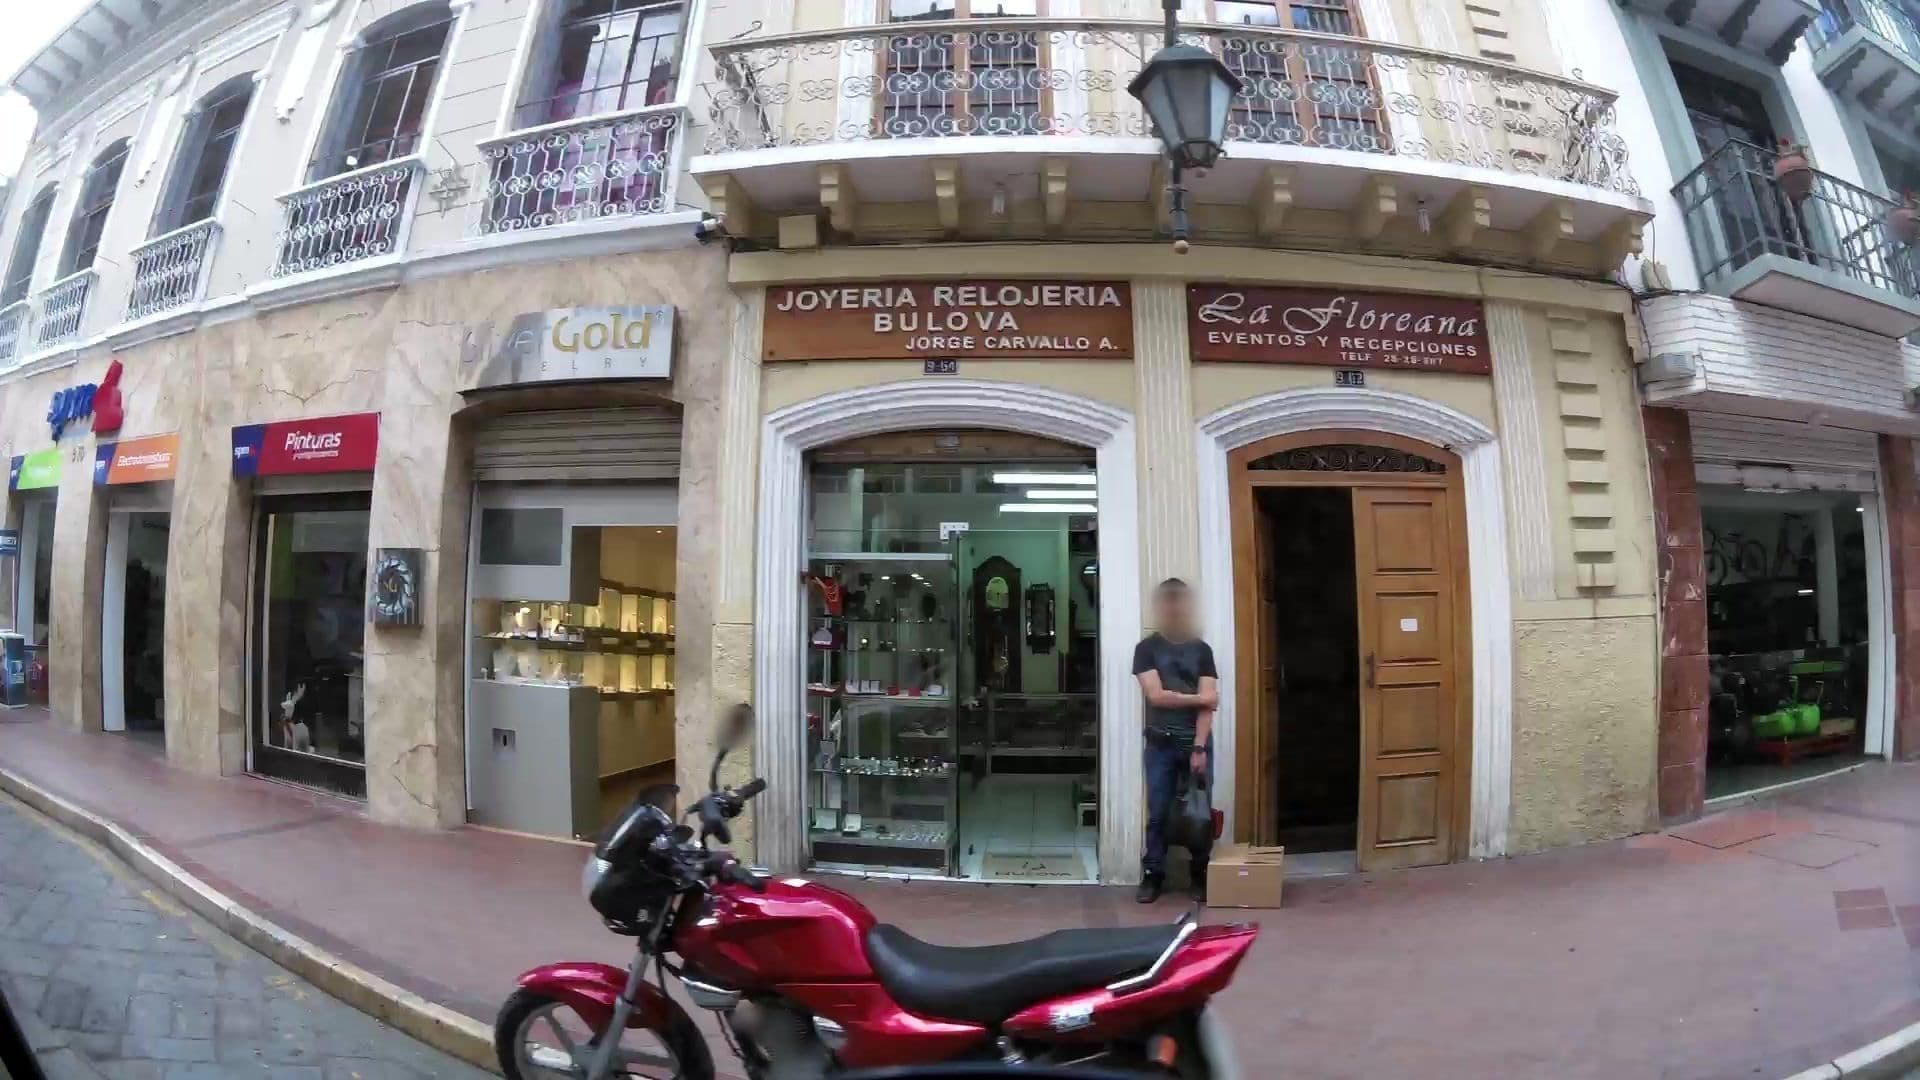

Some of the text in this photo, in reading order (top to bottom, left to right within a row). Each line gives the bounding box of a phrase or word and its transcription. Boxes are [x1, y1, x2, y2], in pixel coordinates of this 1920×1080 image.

[776, 285, 1121, 312] JOYERIA RELOJERIA
[873, 311, 1019, 333] BULOVA
[1198, 292, 1479, 337] La Floreana
[552, 312, 653, 353] Gold
[905, 335, 1118, 350] JORGE CARVALLO A.
[1208, 331, 1478, 357] EVENTOS Y RECEPCIONES
[284, 430, 342, 451] Pinturas
